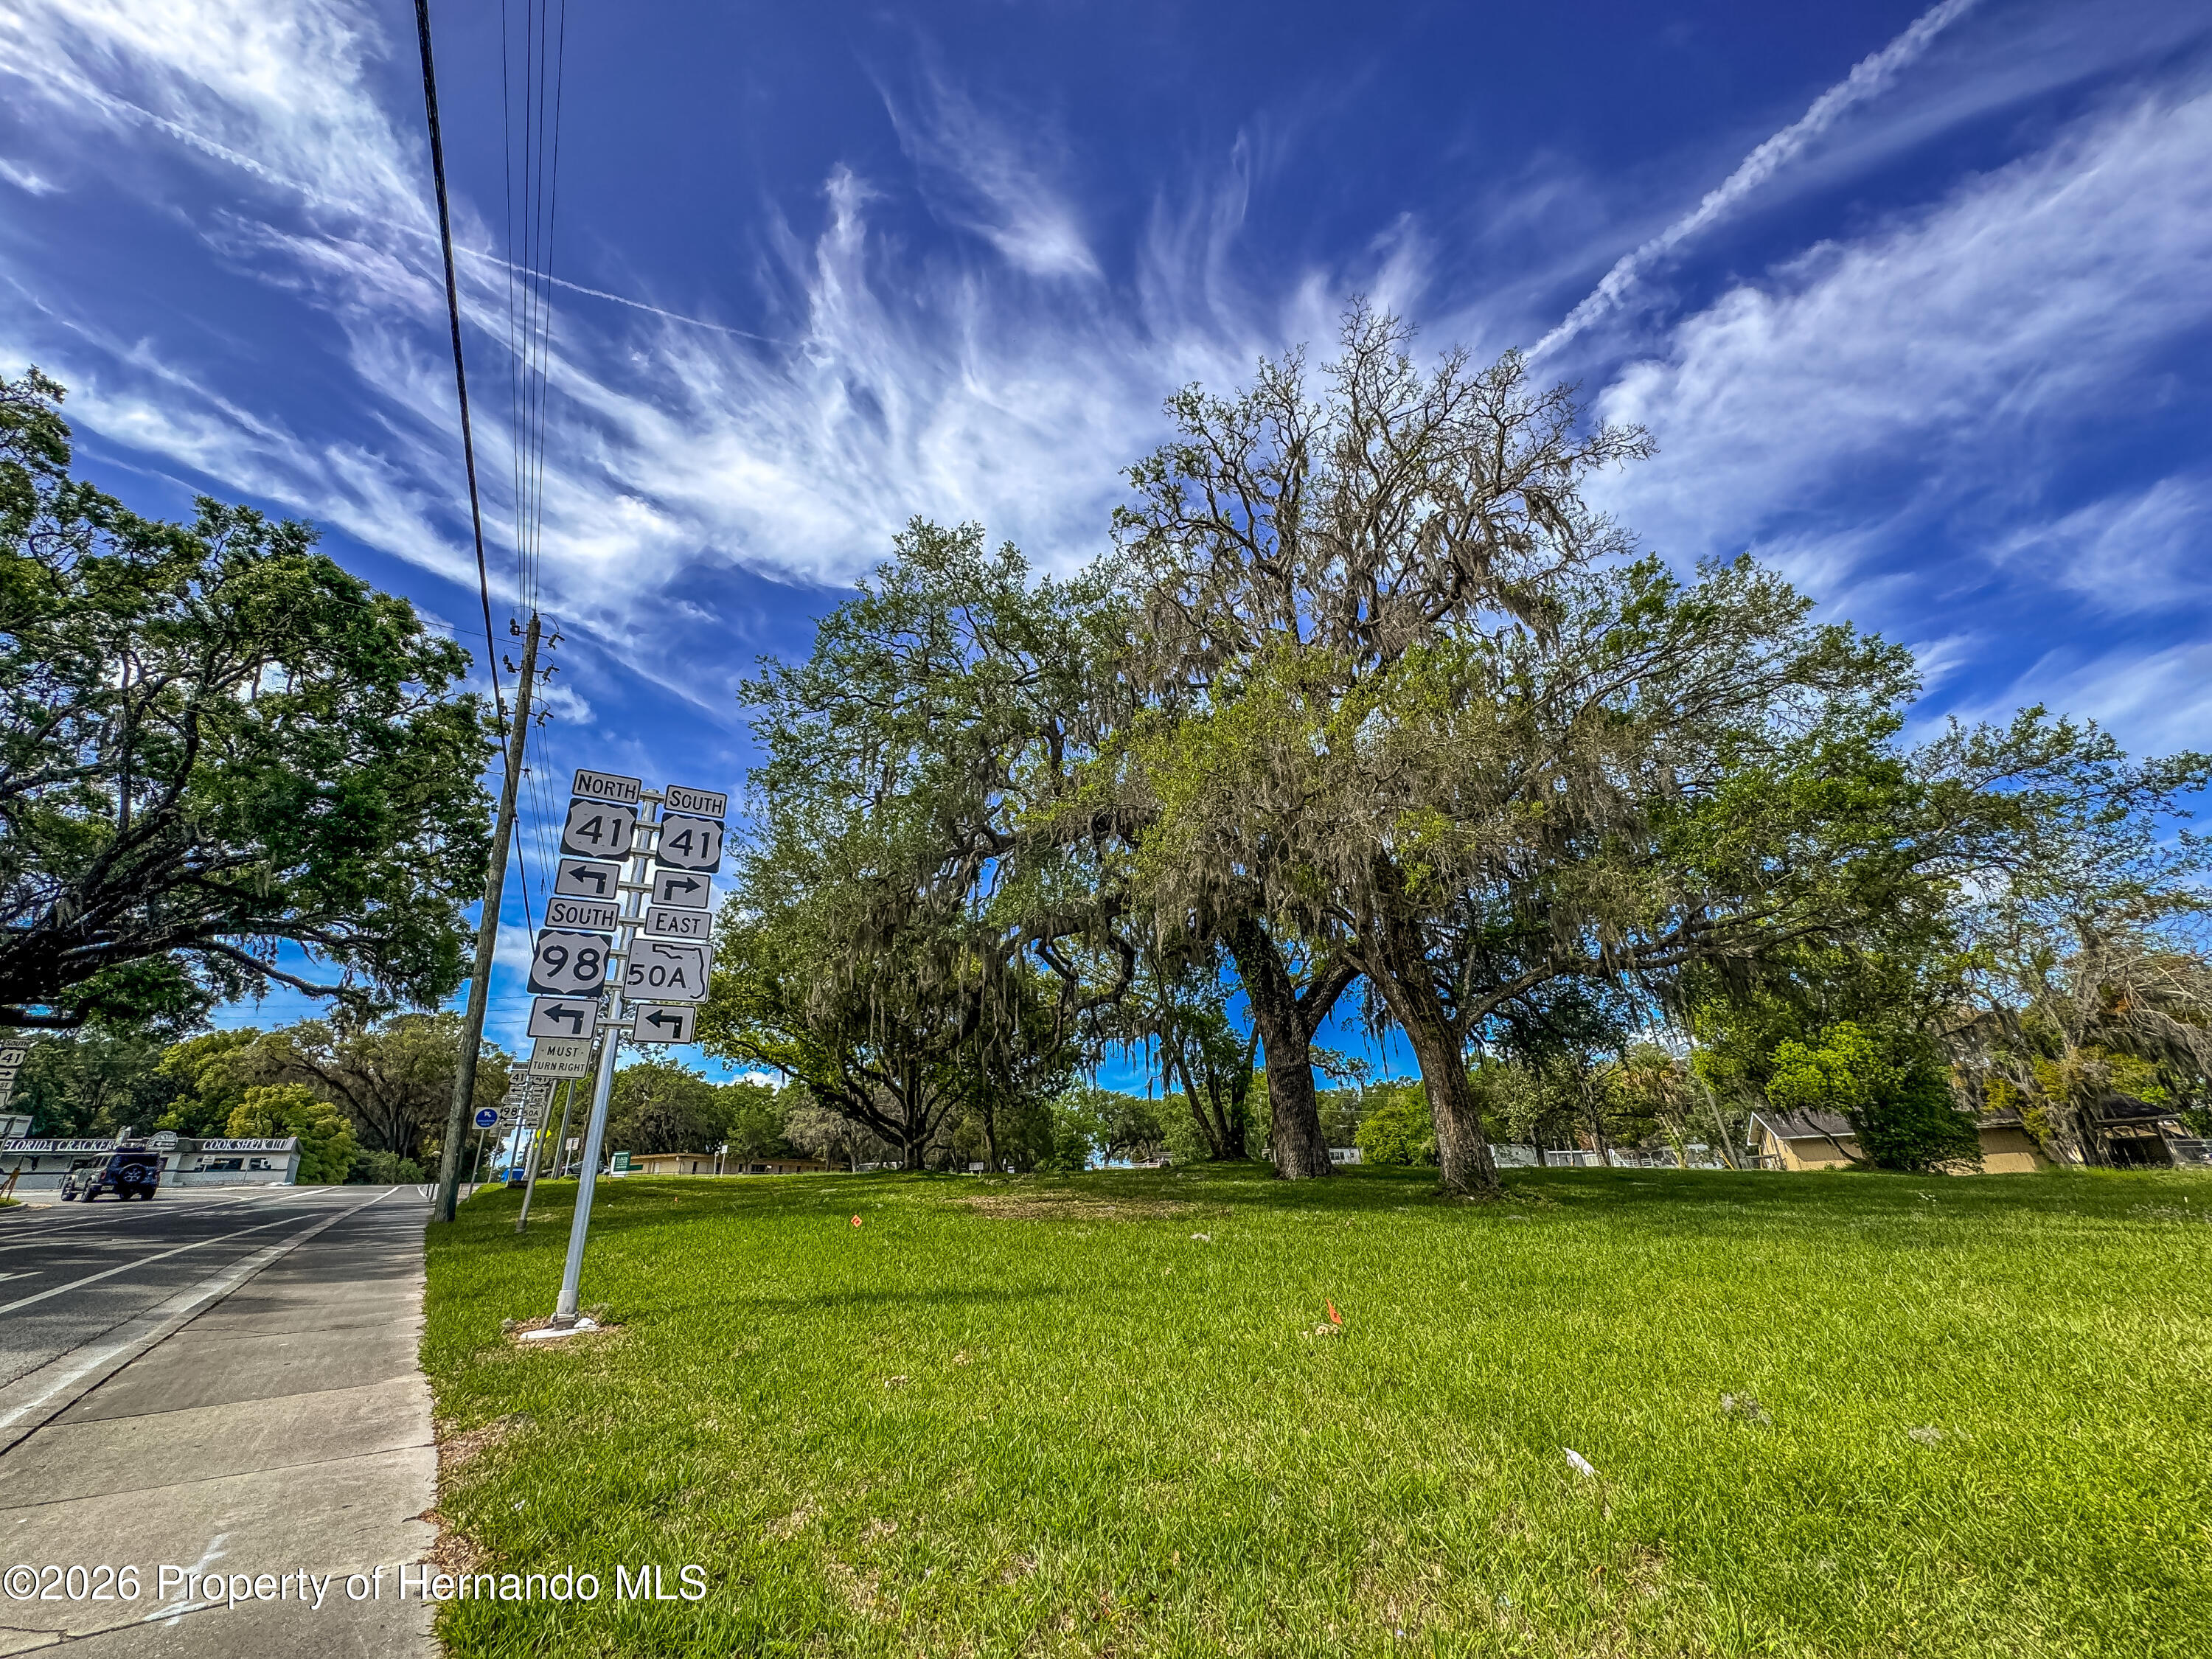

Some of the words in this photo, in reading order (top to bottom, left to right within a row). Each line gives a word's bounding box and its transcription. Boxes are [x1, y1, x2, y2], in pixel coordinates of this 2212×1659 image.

[577, 773, 638, 800] NORTH
[669, 790, 723, 814] SOUTH
[575, 815, 622, 847] 41
[668, 829, 711, 859] 41
[552, 902, 614, 927] SOUTH
[655, 912, 701, 934] EAST
[542, 945, 601, 981] 98
[627, 964, 686, 989] 50A
[1, 1053, 21, 1063] 41
[546, 1046, 580, 1057] MUST
[512, 1073, 524, 1082] 41
[533, 1061, 557, 1071] TURN
[558, 1062, 586, 1072] RIGHT
[504, 1107, 518, 1116] 98
[4, 1139, 53, 1151] FLORIDA
[201, 1139, 235, 1150] COOK
